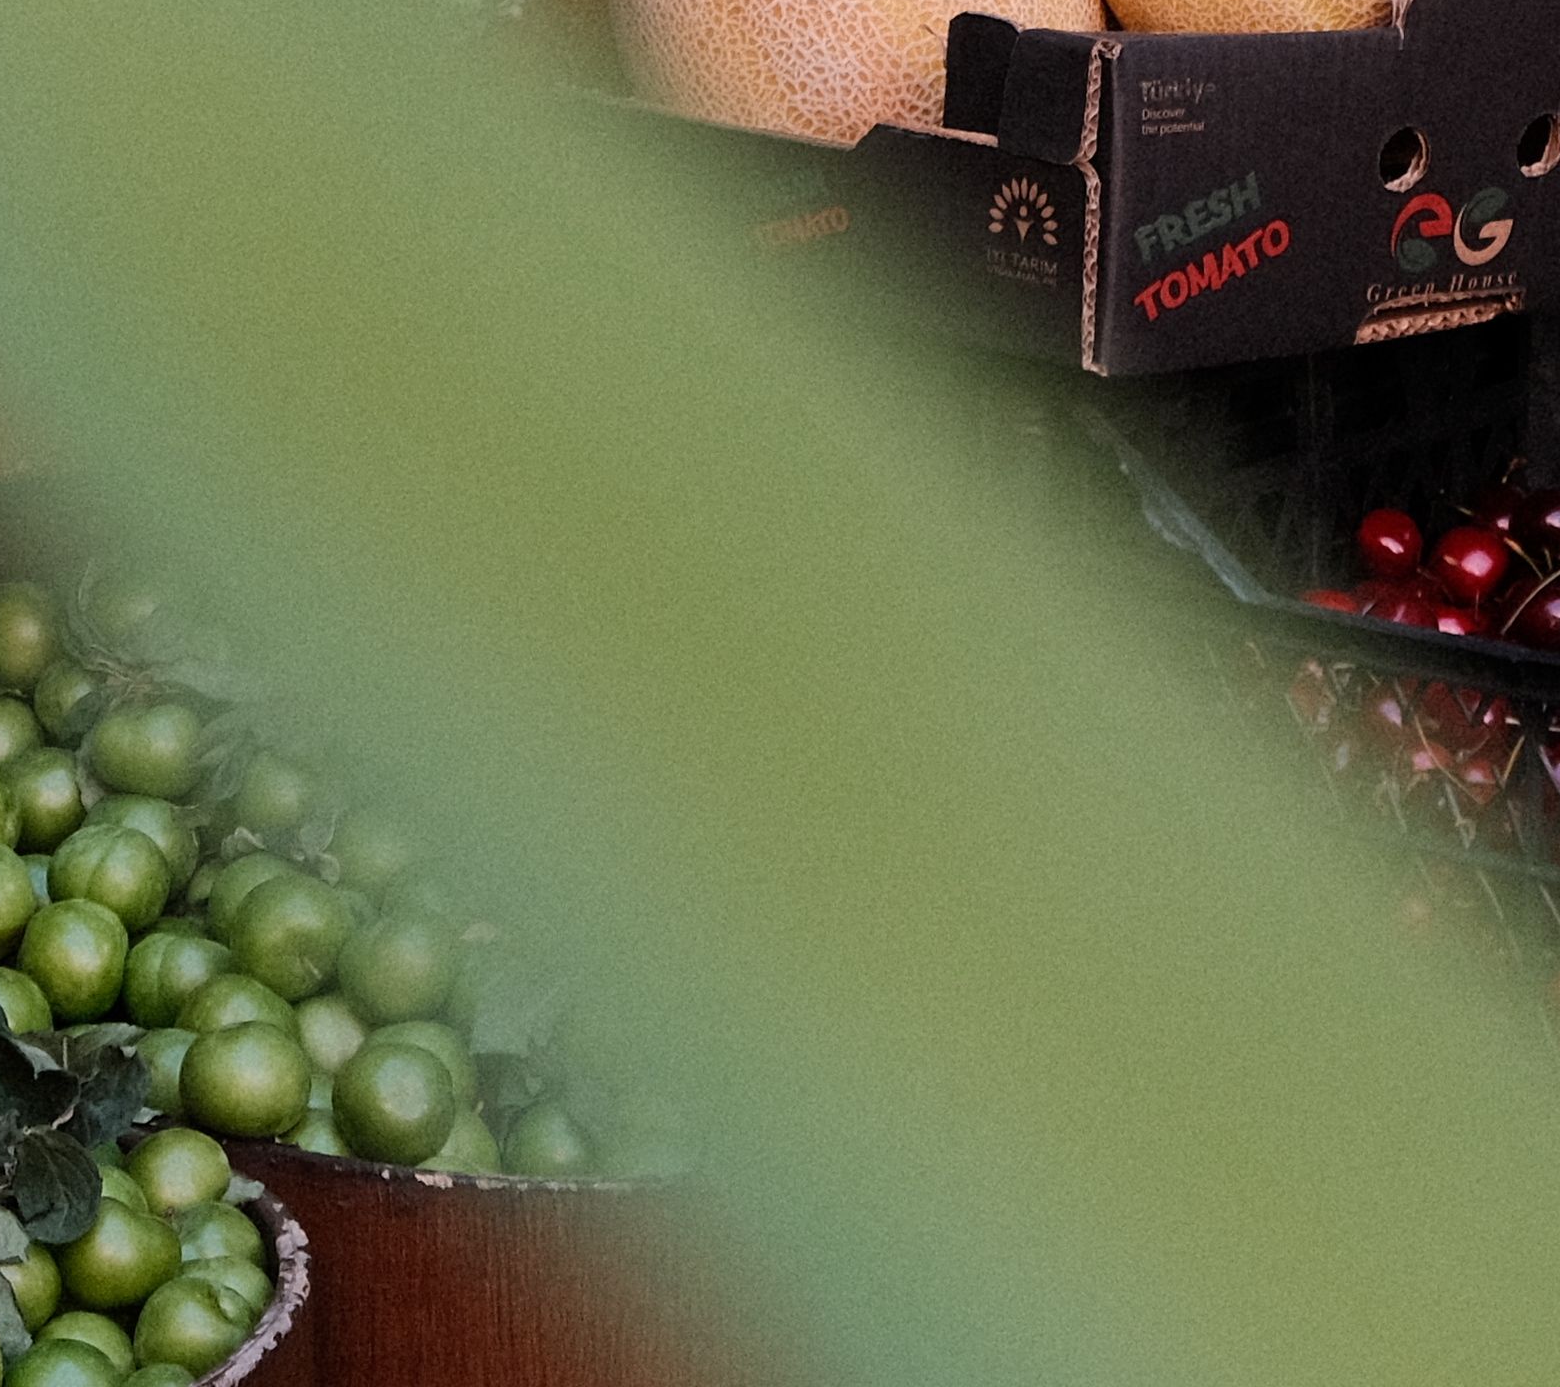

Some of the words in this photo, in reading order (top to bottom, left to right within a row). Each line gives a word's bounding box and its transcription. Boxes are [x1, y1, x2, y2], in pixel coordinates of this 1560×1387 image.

[1142, 108, 1185, 120] Discover
[1160, 121, 1205, 137] potential
[1134, 171, 1263, 265] FRESH
[1011, 252, 1058, 277] TARIM
[1133, 219, 1291, 322] TOMATO
[1450, 271, 1519, 293] House
